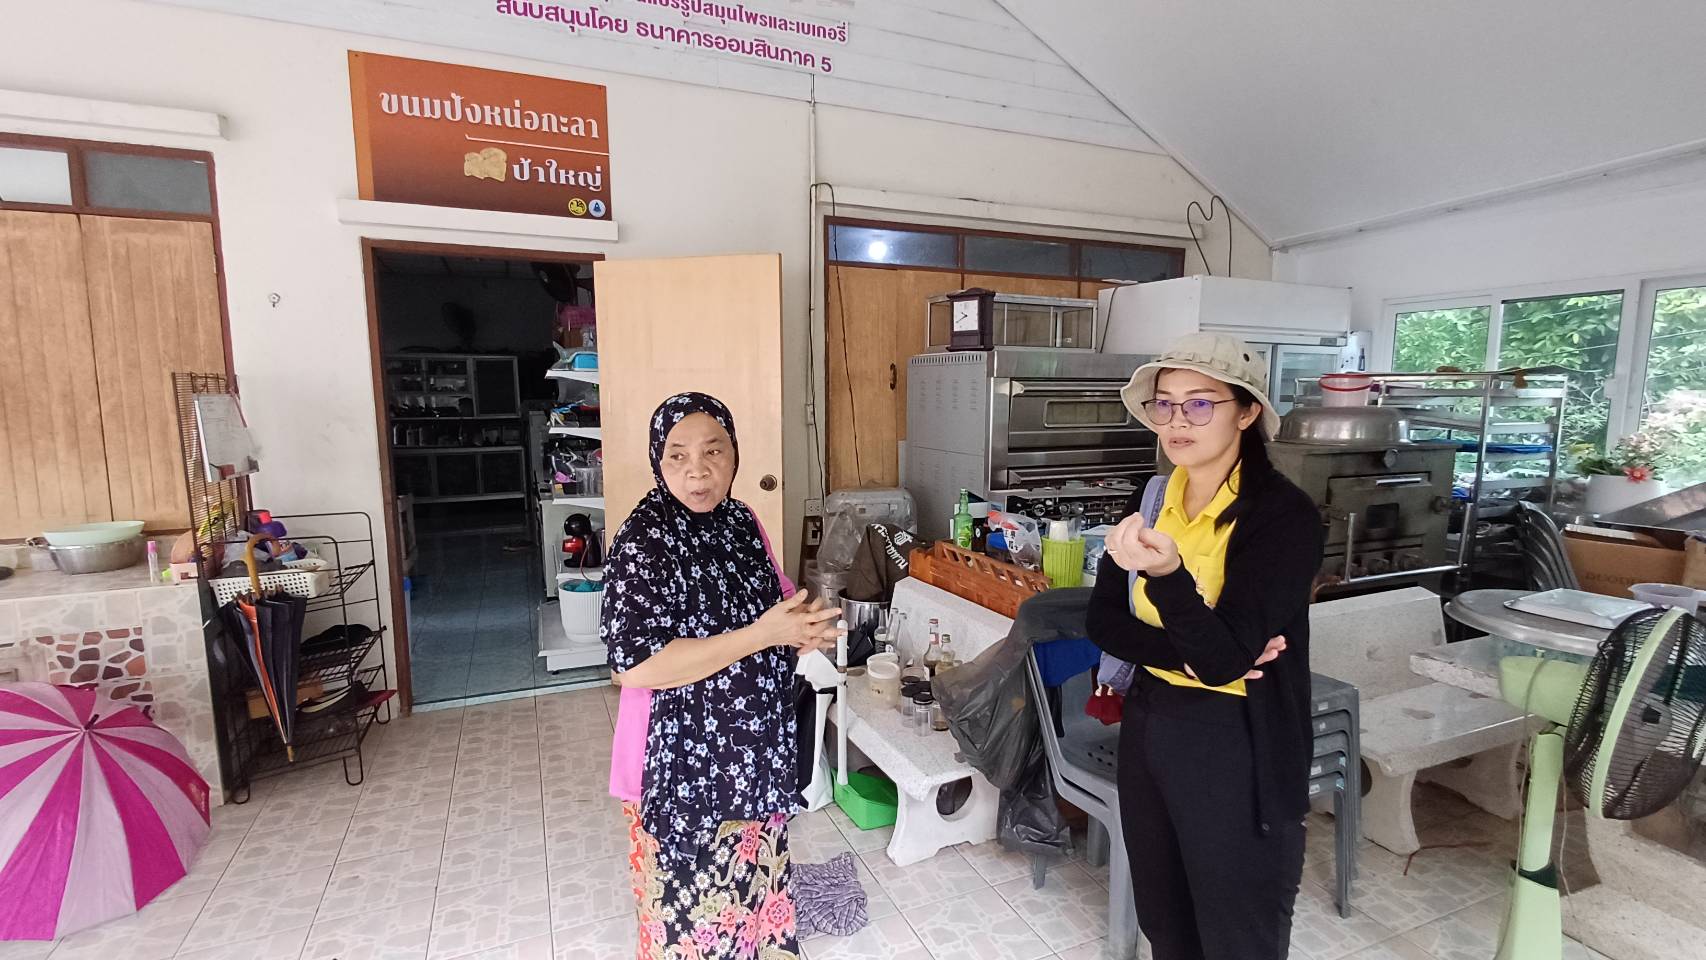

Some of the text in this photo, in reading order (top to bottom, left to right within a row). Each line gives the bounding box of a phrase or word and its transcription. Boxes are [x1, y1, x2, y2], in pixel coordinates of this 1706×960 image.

[496, 0, 832, 73] สนบสนุนโดย ธนาคารออมสินภาค 5
[379, 92, 600, 139] ขนมปังหน่อกะลา
[512, 157, 602, 192] ป้าใหญ่
